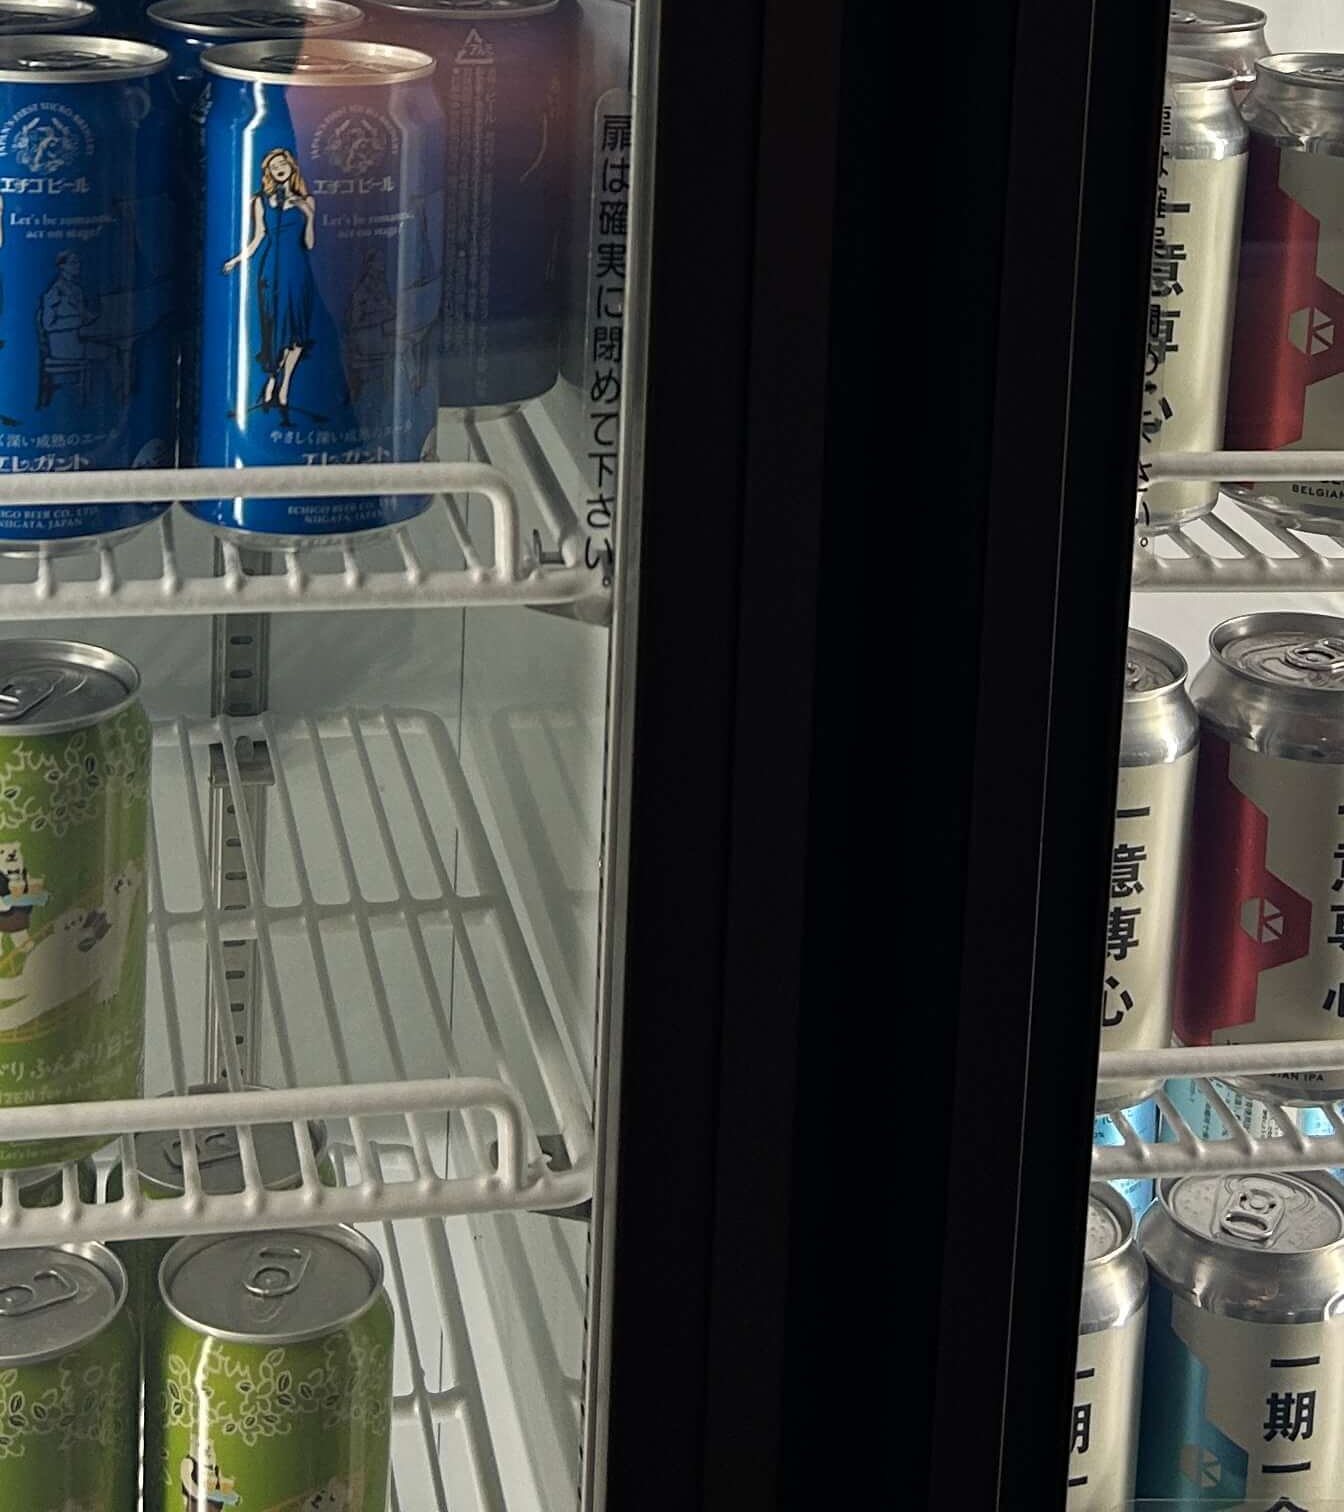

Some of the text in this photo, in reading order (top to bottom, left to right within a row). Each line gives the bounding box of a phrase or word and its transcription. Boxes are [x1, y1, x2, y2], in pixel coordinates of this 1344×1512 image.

[584, 113, 634, 589] 扉は確実に閉めて下さい。
